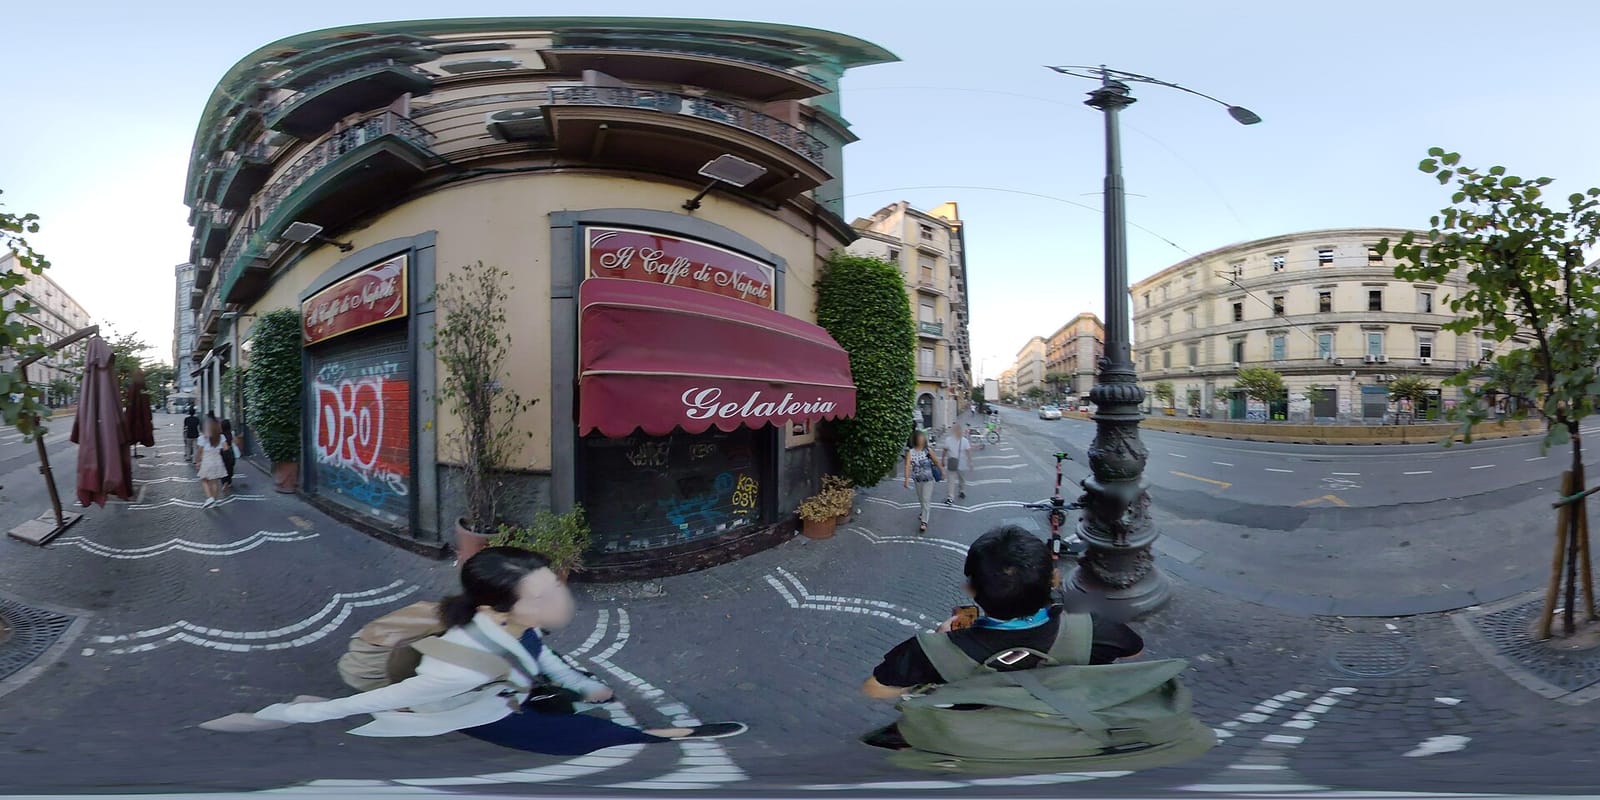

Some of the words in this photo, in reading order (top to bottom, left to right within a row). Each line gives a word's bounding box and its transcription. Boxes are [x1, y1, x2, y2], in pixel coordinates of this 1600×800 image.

[600, 246, 635, 270] Il
[639, 247, 690, 285] Caffé
[693, 263, 713, 282] di
[714, 270, 769, 300] Napoli
[681, 387, 837, 419] Gelateria
